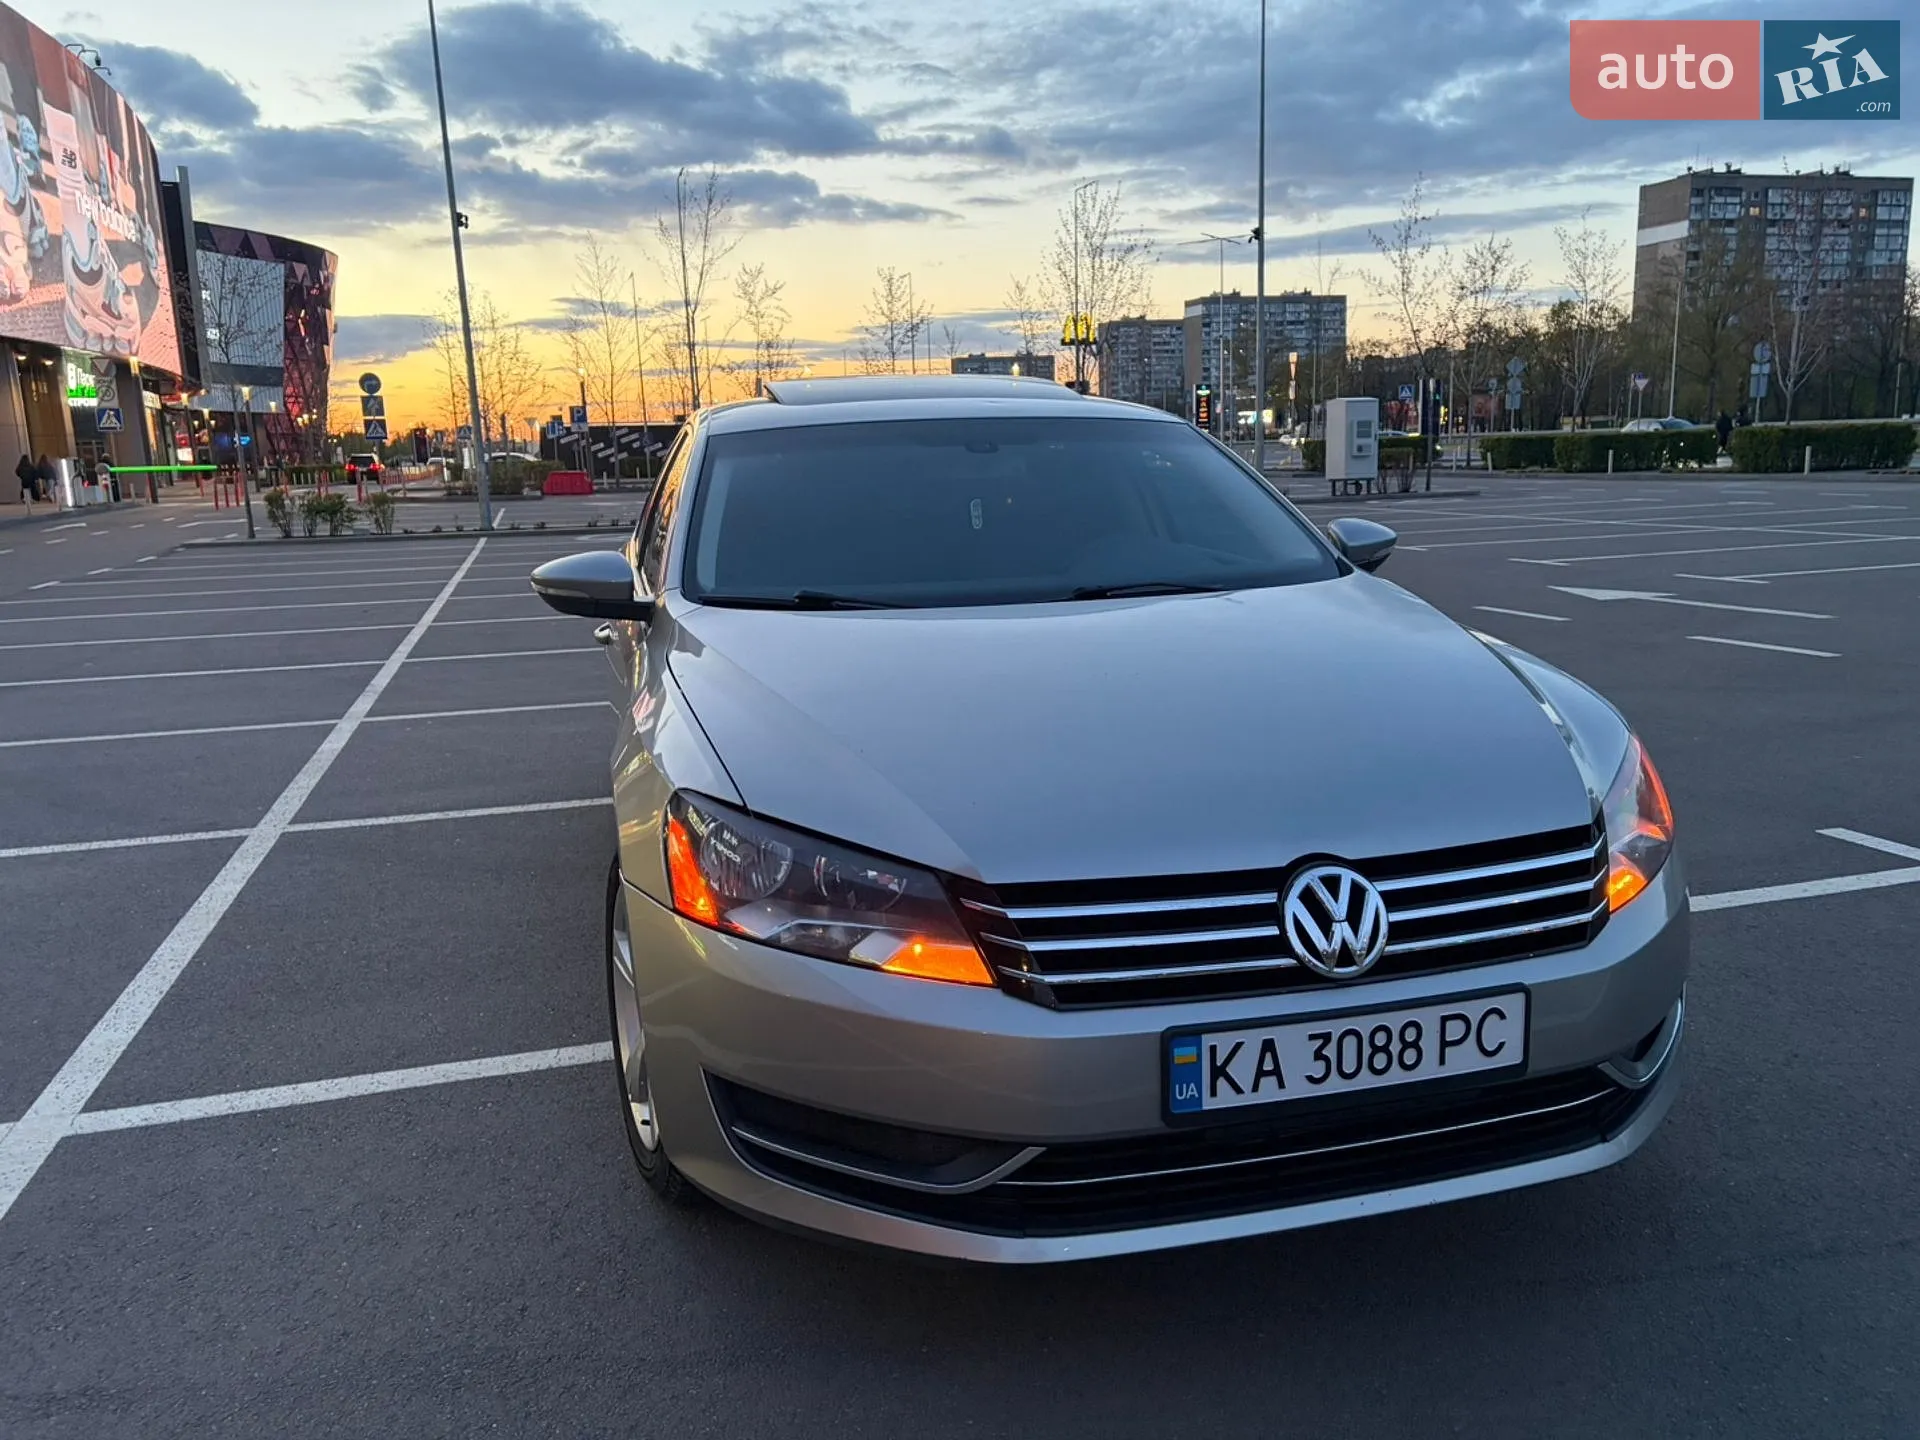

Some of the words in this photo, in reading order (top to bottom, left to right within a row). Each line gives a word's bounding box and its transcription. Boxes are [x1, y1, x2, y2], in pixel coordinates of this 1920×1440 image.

[75, 189, 102, 222] new
[1208, 1037, 1287, 1098] KA
[1304, 1019, 1424, 1085] 3088
[1438, 1006, 1508, 1067] PC
[1175, 1082, 1199, 1100] UA
